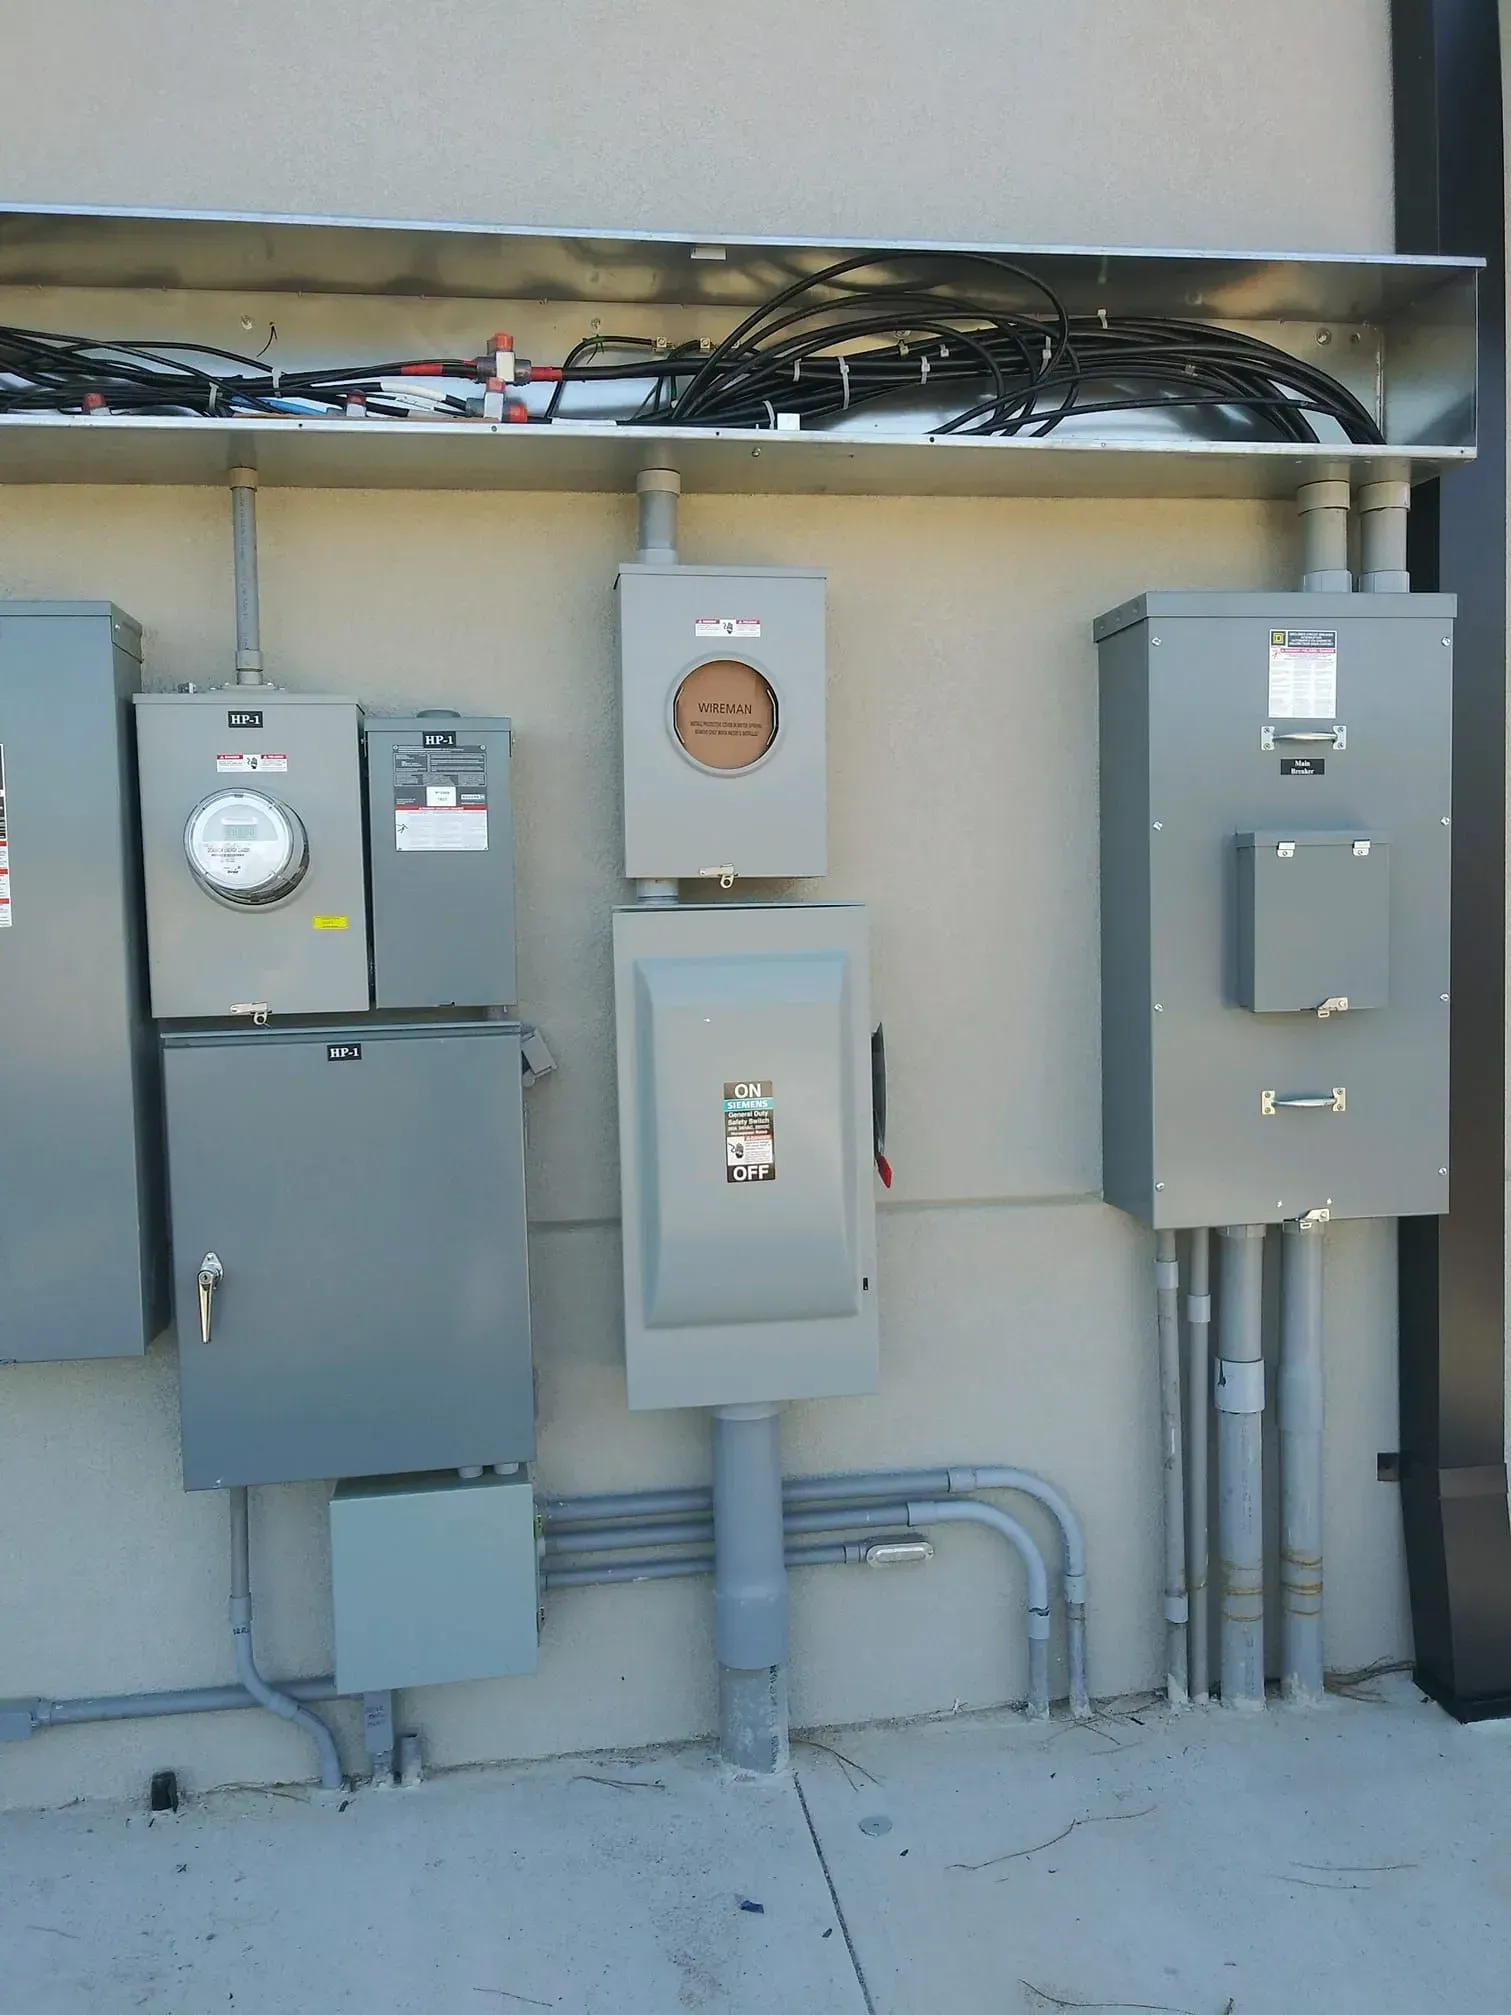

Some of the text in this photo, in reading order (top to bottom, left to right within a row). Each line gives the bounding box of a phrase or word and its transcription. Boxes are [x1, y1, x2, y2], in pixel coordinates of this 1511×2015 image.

[698, 702, 752, 714] WIREMAN
[230, 714, 261, 725] HP-1
[424, 735, 454, 745] HP-1
[1294, 759, 1311, 767] Main
[329, 1047, 360, 1058] HP-1
[734, 1083, 762, 1098] ON
[727, 1100, 768, 1110] SIEMENS
[728, 1110, 769, 1119] General Duty
[727, 1117, 770, 1126] Safety Switch
[733, 1164, 770, 1181] OFF
